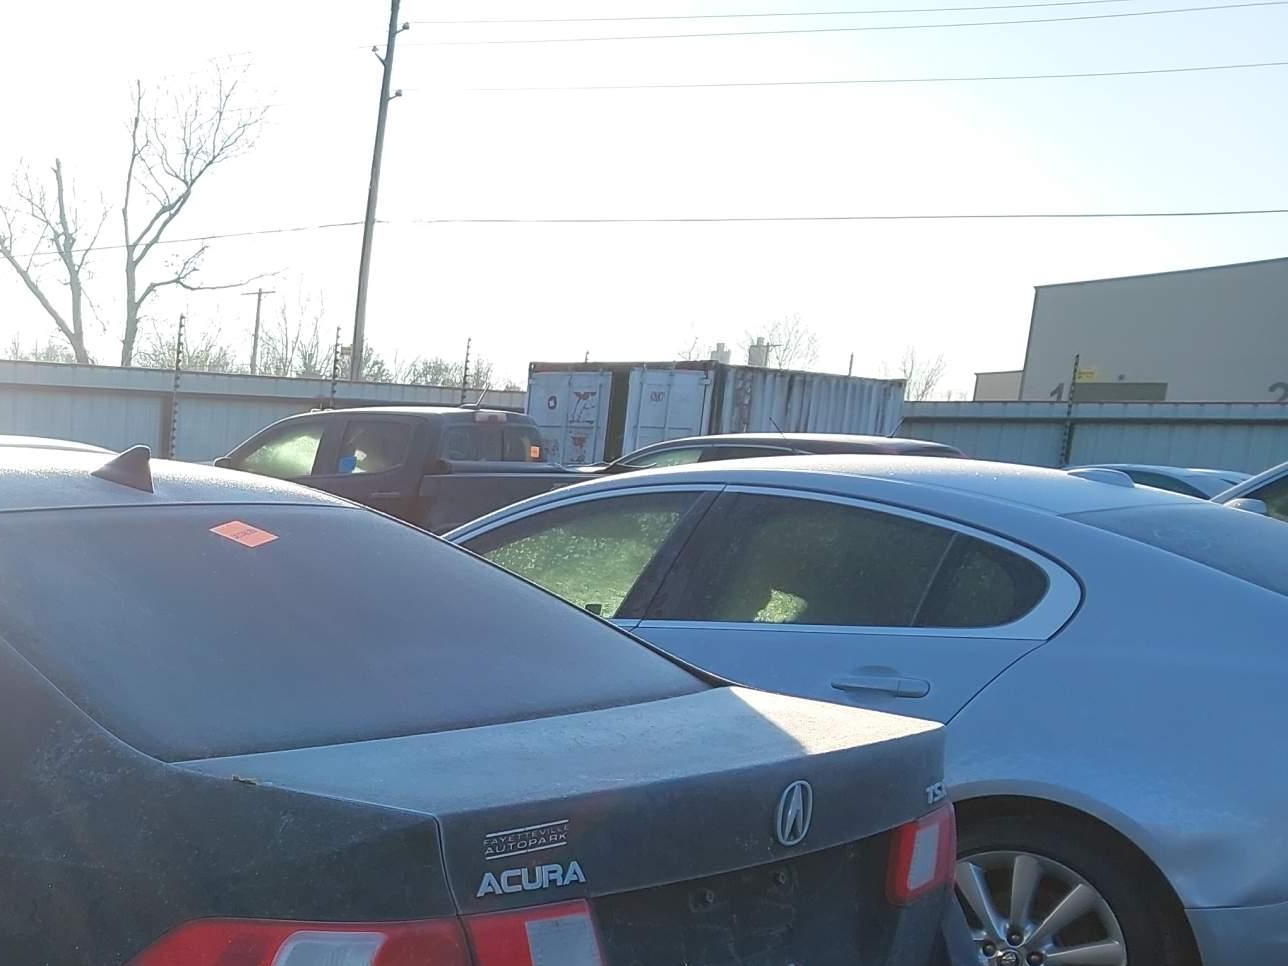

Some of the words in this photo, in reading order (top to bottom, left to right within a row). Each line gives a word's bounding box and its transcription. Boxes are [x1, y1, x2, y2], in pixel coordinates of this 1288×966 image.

[483, 823, 569, 846] FAYETTEVILLE
[484, 832, 568, 855] AUTOPARK
[476, 860, 587, 897] ACURA
